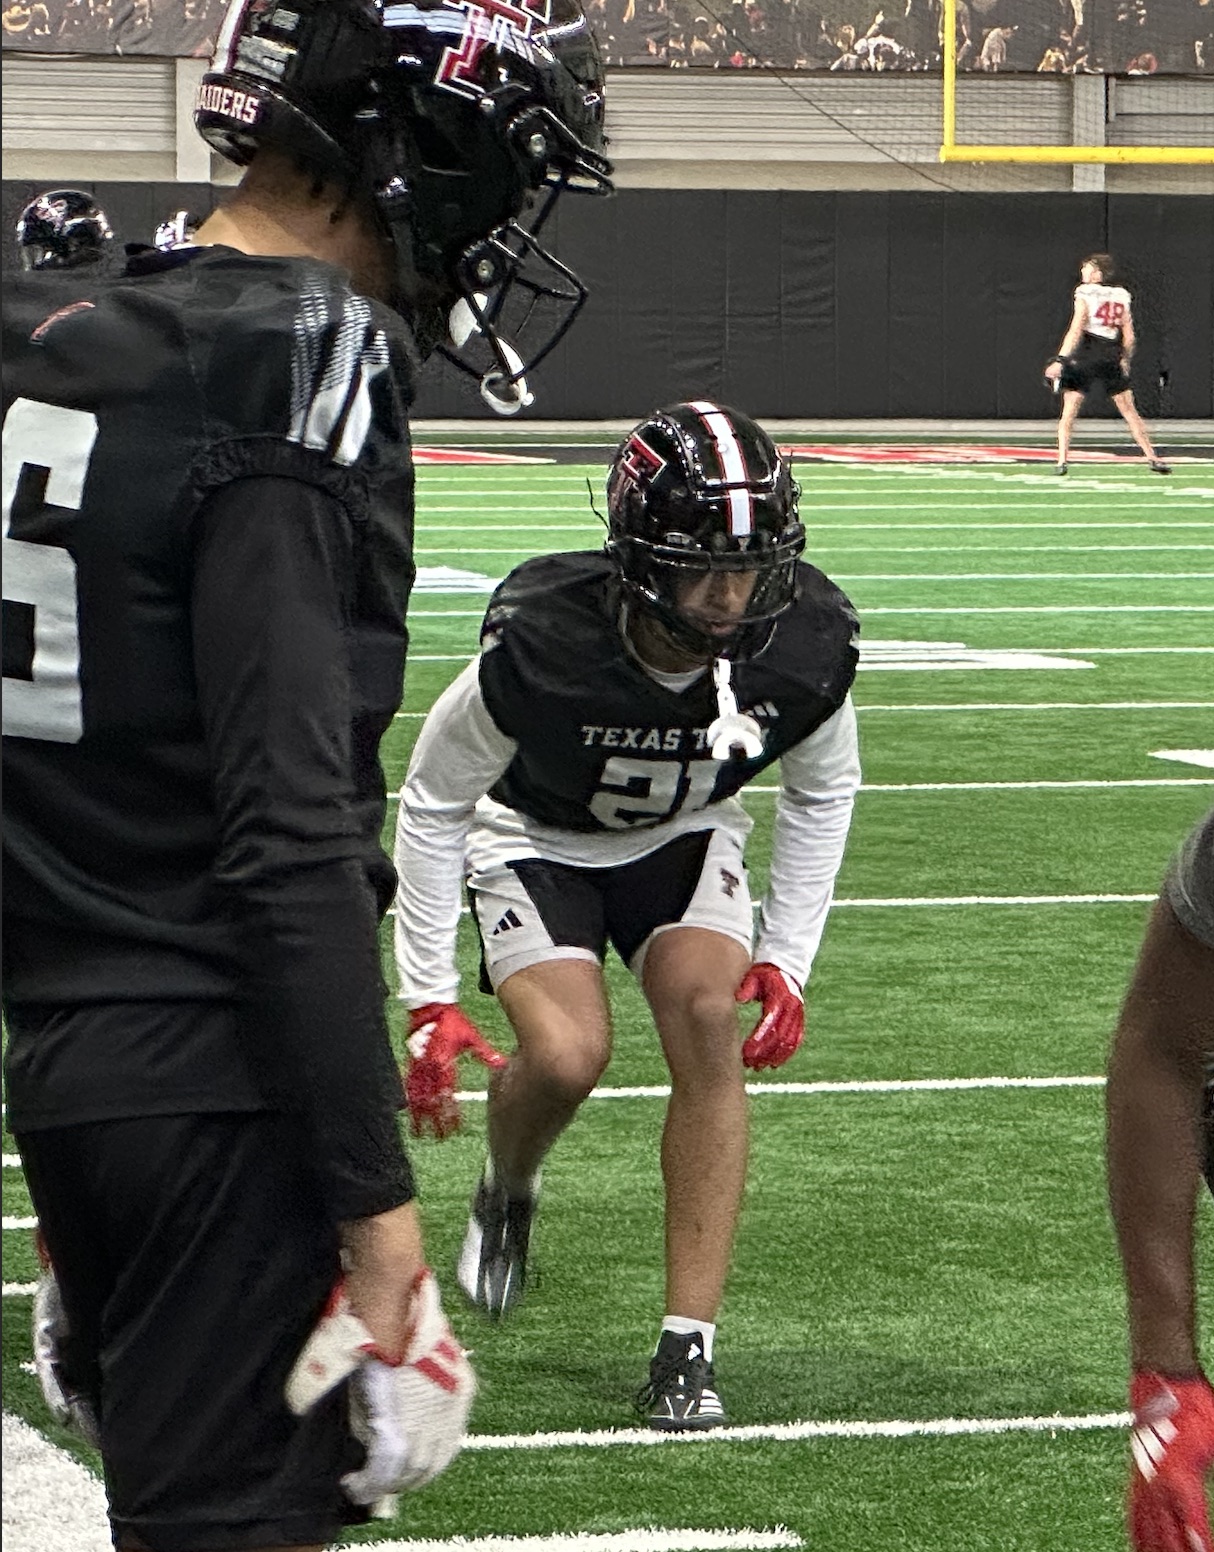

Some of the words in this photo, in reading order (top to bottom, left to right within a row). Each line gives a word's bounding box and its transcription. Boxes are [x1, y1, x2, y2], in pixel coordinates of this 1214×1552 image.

[197, 84, 260, 124] AIDERS
[581, 725, 683, 750] TEXAS
[587, 756, 724, 829] 21
